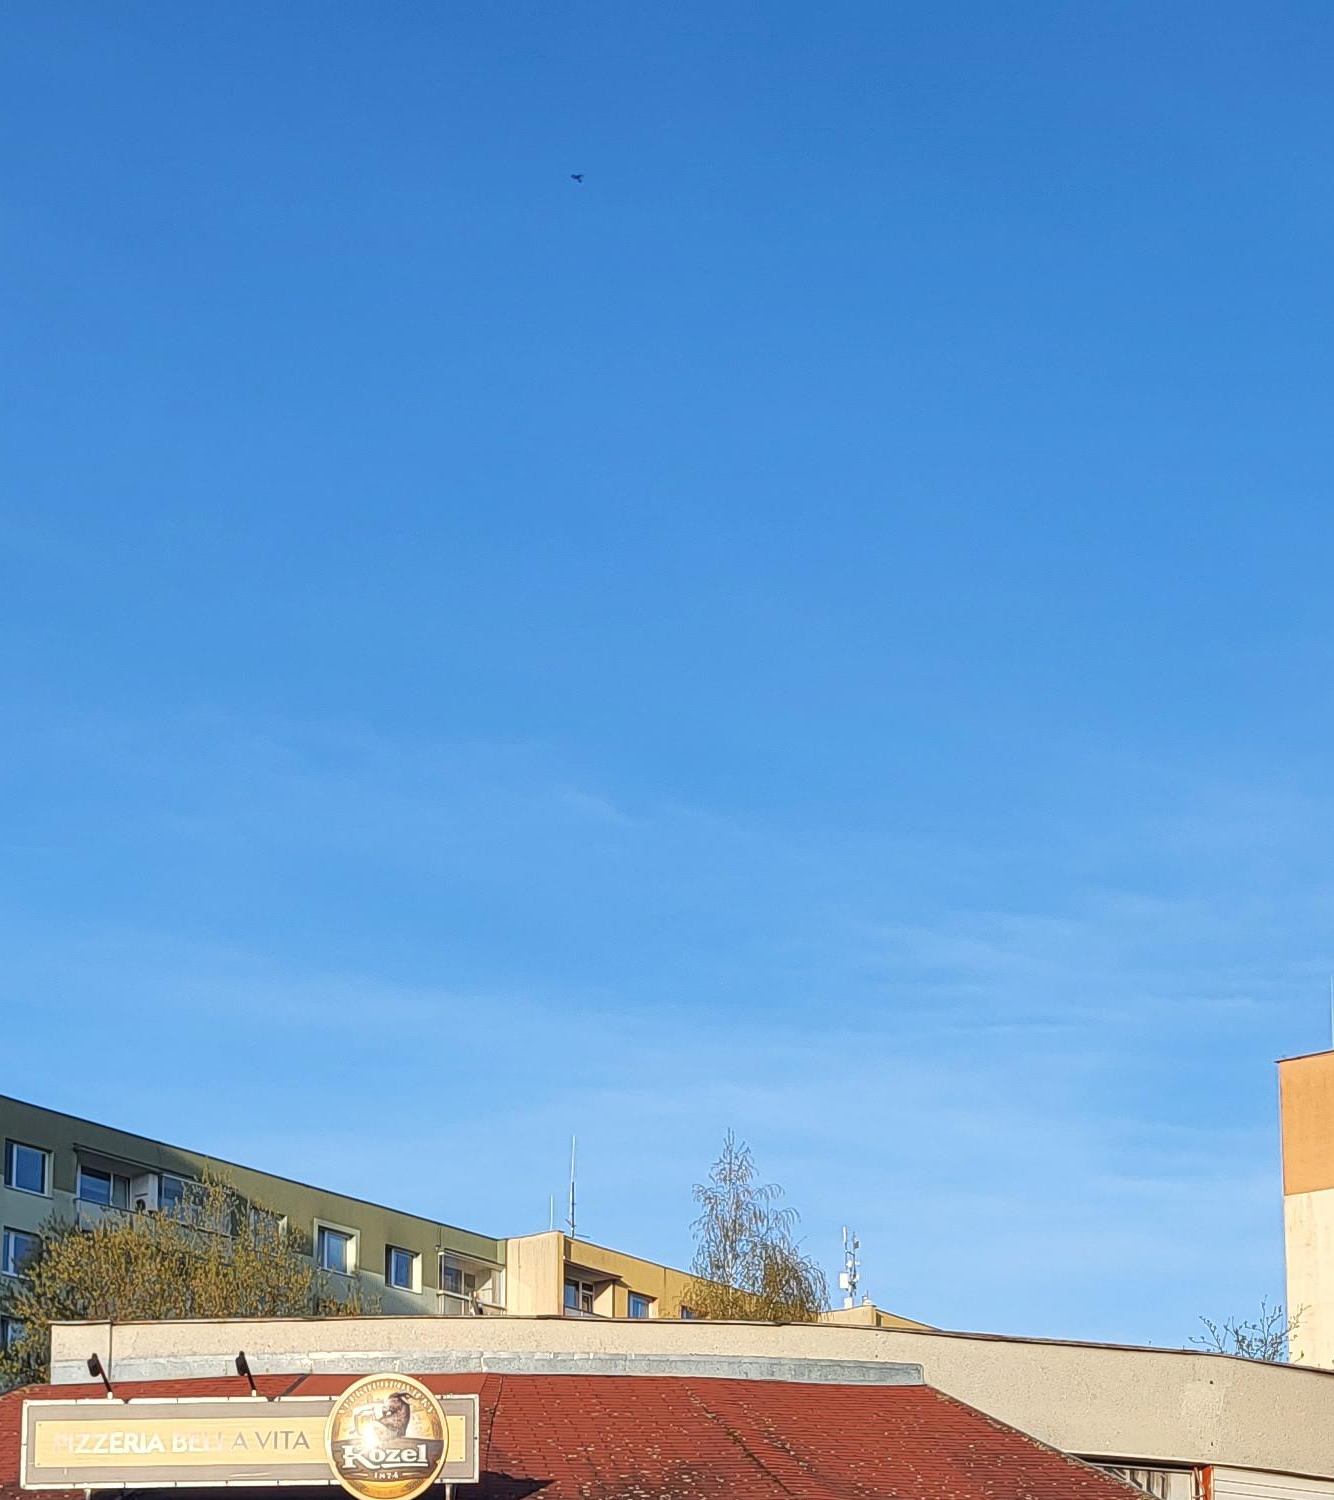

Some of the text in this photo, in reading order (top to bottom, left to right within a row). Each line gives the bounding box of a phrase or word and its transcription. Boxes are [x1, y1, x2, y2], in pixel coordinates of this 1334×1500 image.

[53, 1431, 166, 1455] PIZZERIA
[254, 1430, 311, 1451] VITA
[341, 1443, 429, 1470] Kozel
